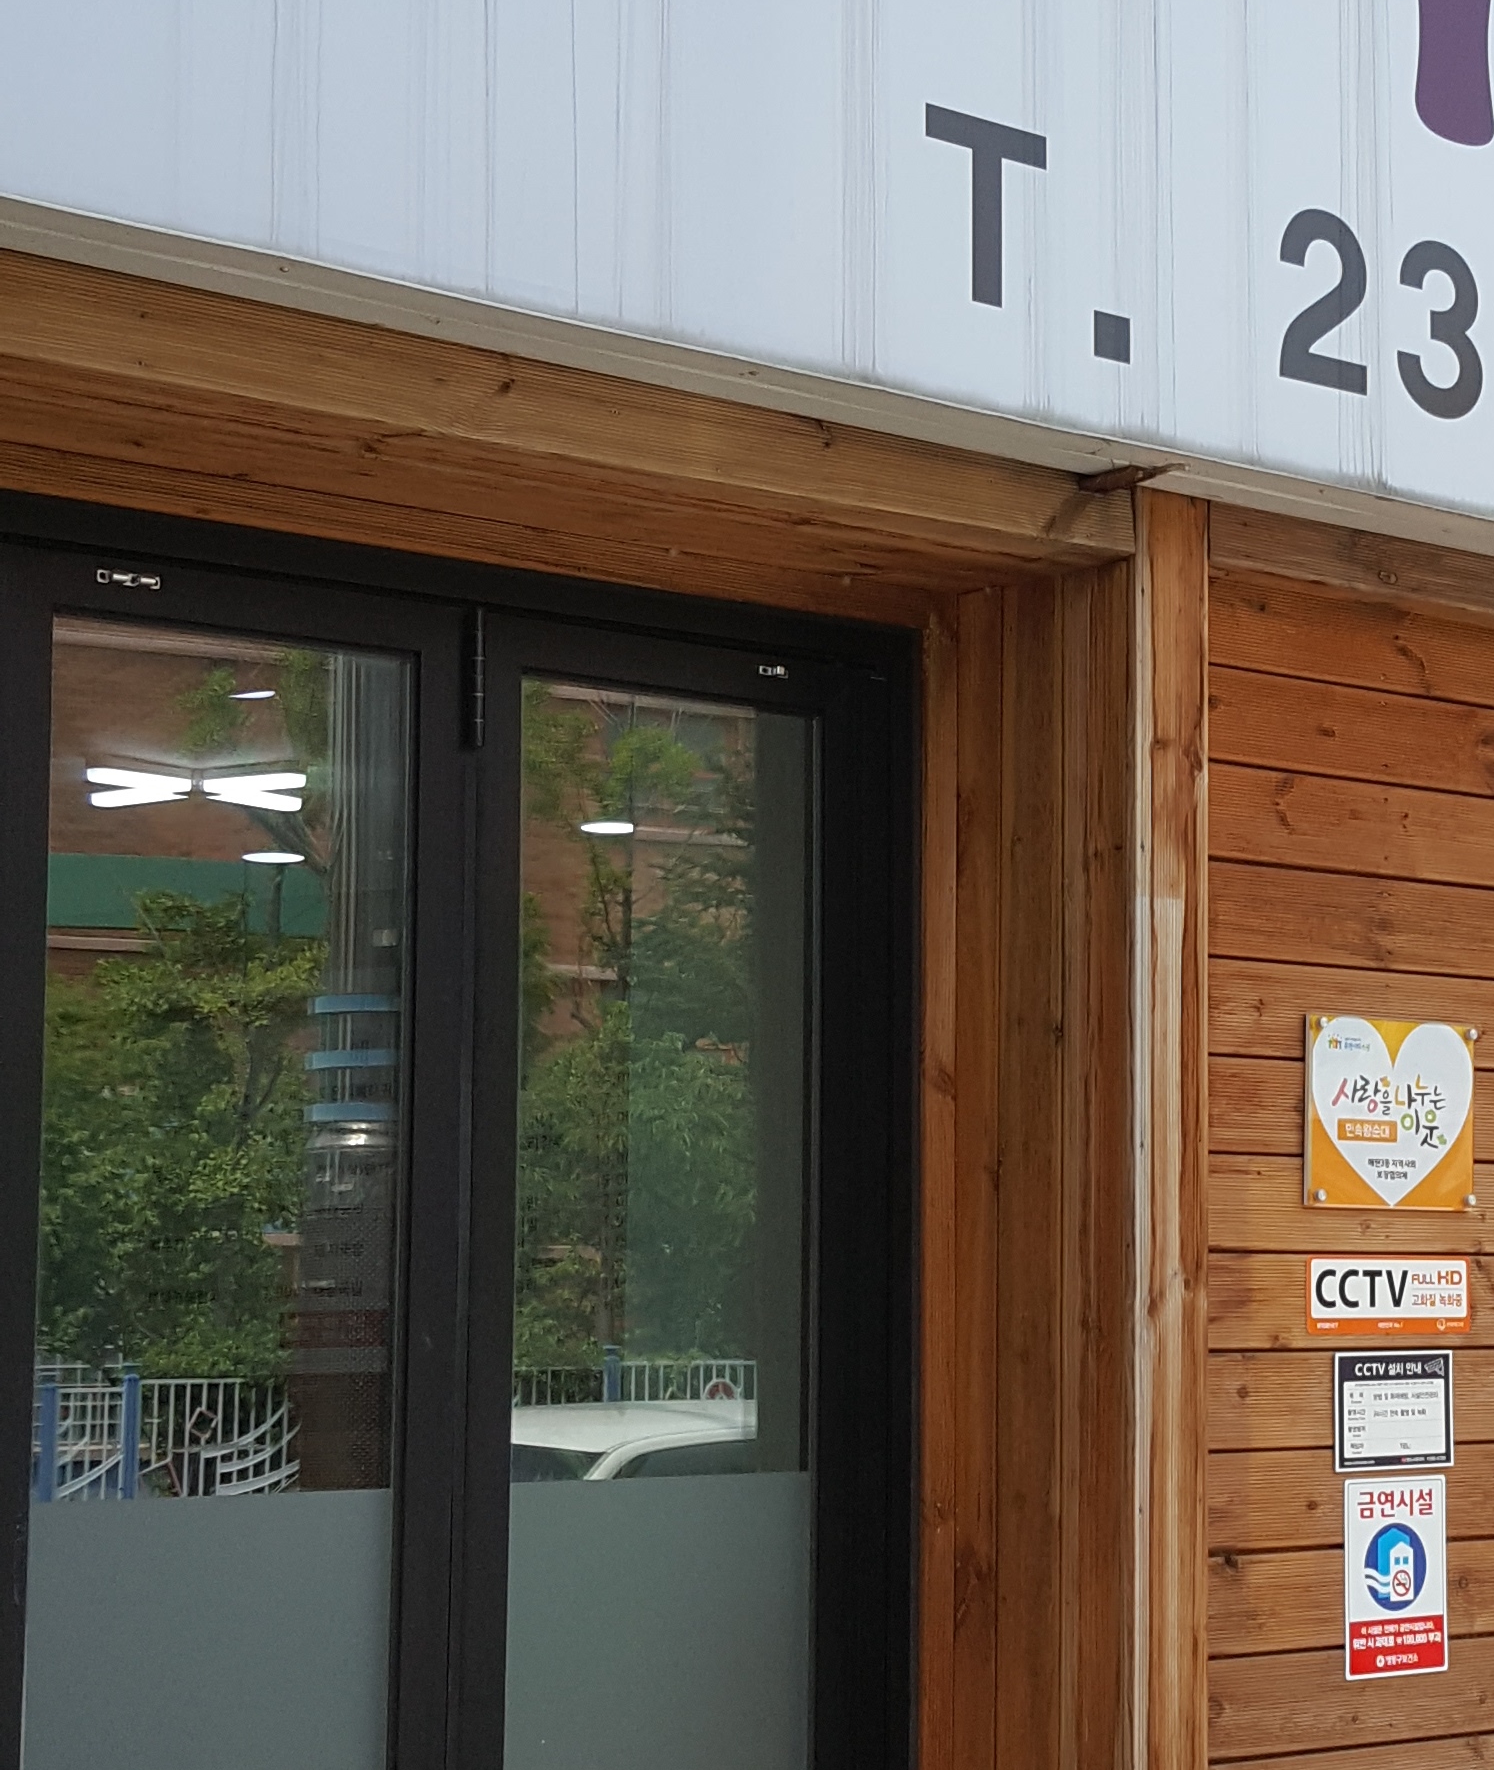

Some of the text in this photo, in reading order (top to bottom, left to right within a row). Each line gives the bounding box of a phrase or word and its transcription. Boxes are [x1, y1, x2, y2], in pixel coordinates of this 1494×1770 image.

[924, 102, 1131, 364] T.
[1331, 1074, 1446, 1115] 사랑을 나누는
[1400, 1108, 1440, 1148] 이웃
[1315, 1268, 1409, 1309] CCTV
[1411, 1270, 1463, 1285] FULL HD
[1411, 1293, 1463, 1308] 고화질 녹화중
[1354, 1361, 1422, 1377] CCTV 설치 안내
[1356, 1487, 1434, 1519] 금연시설
